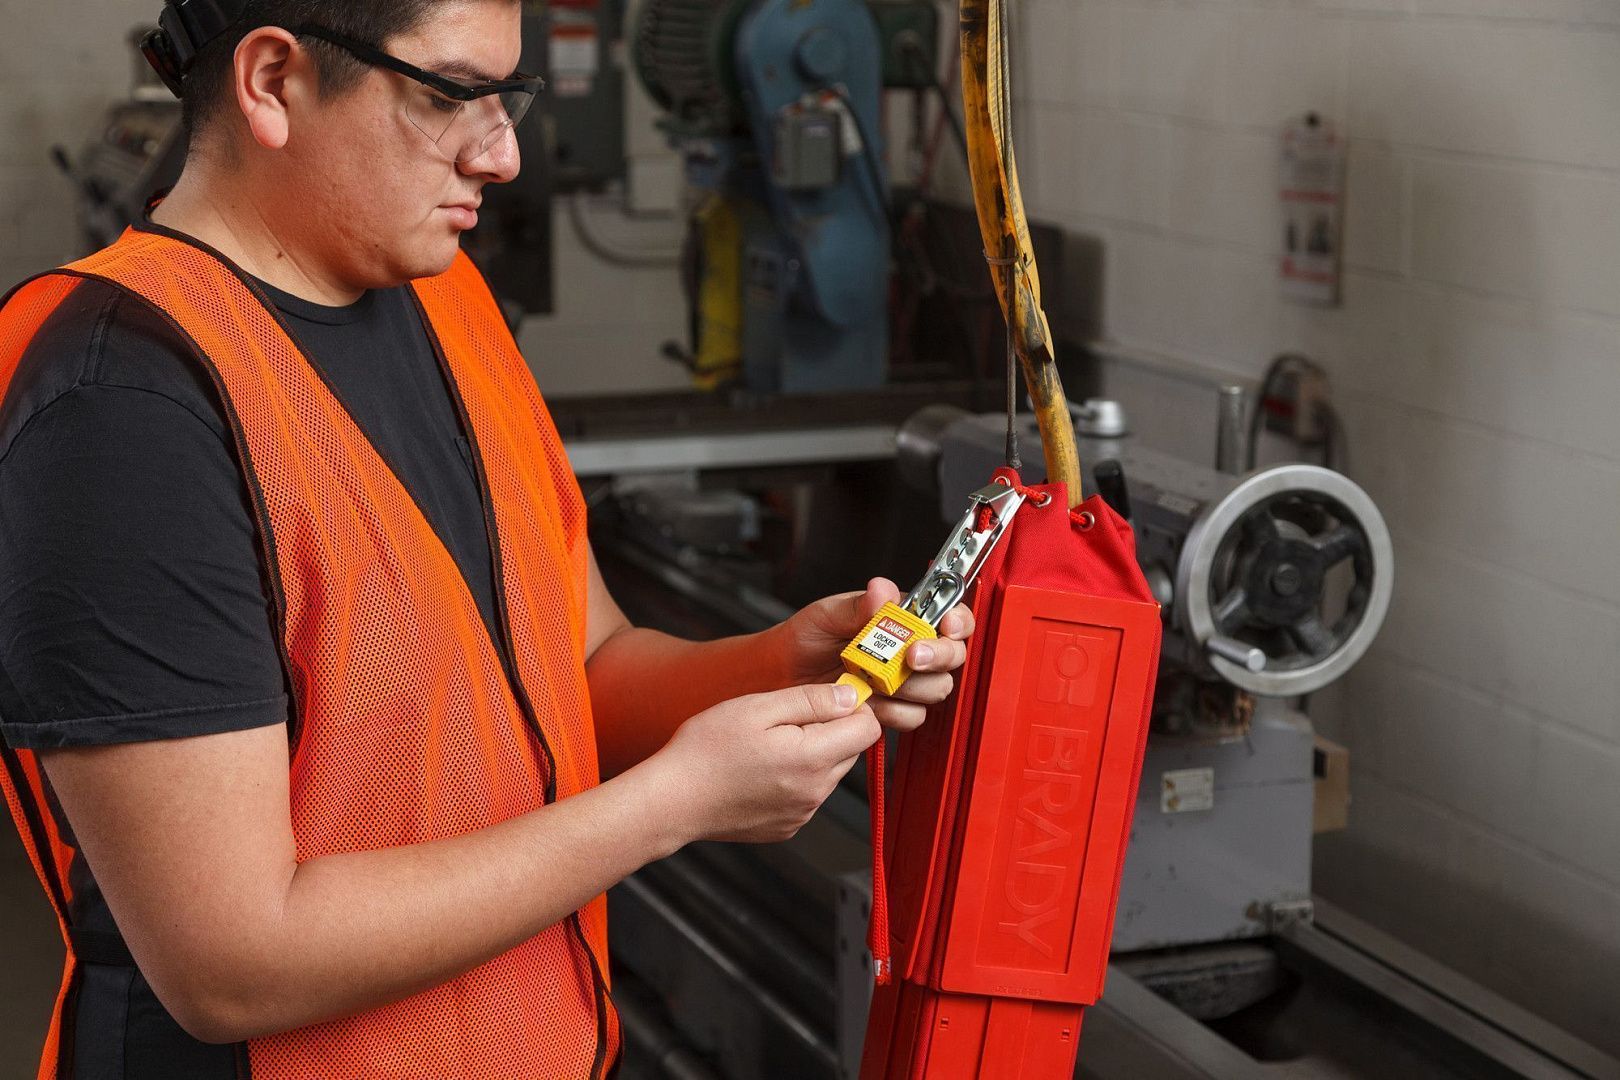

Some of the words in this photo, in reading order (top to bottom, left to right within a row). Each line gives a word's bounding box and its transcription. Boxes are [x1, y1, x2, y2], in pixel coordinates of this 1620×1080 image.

[887, 621, 911, 639] DANGER
[873, 632, 897, 648] LOCKED
[873, 640, 887, 650] OUT
[999, 723, 1089, 960] BRADY
